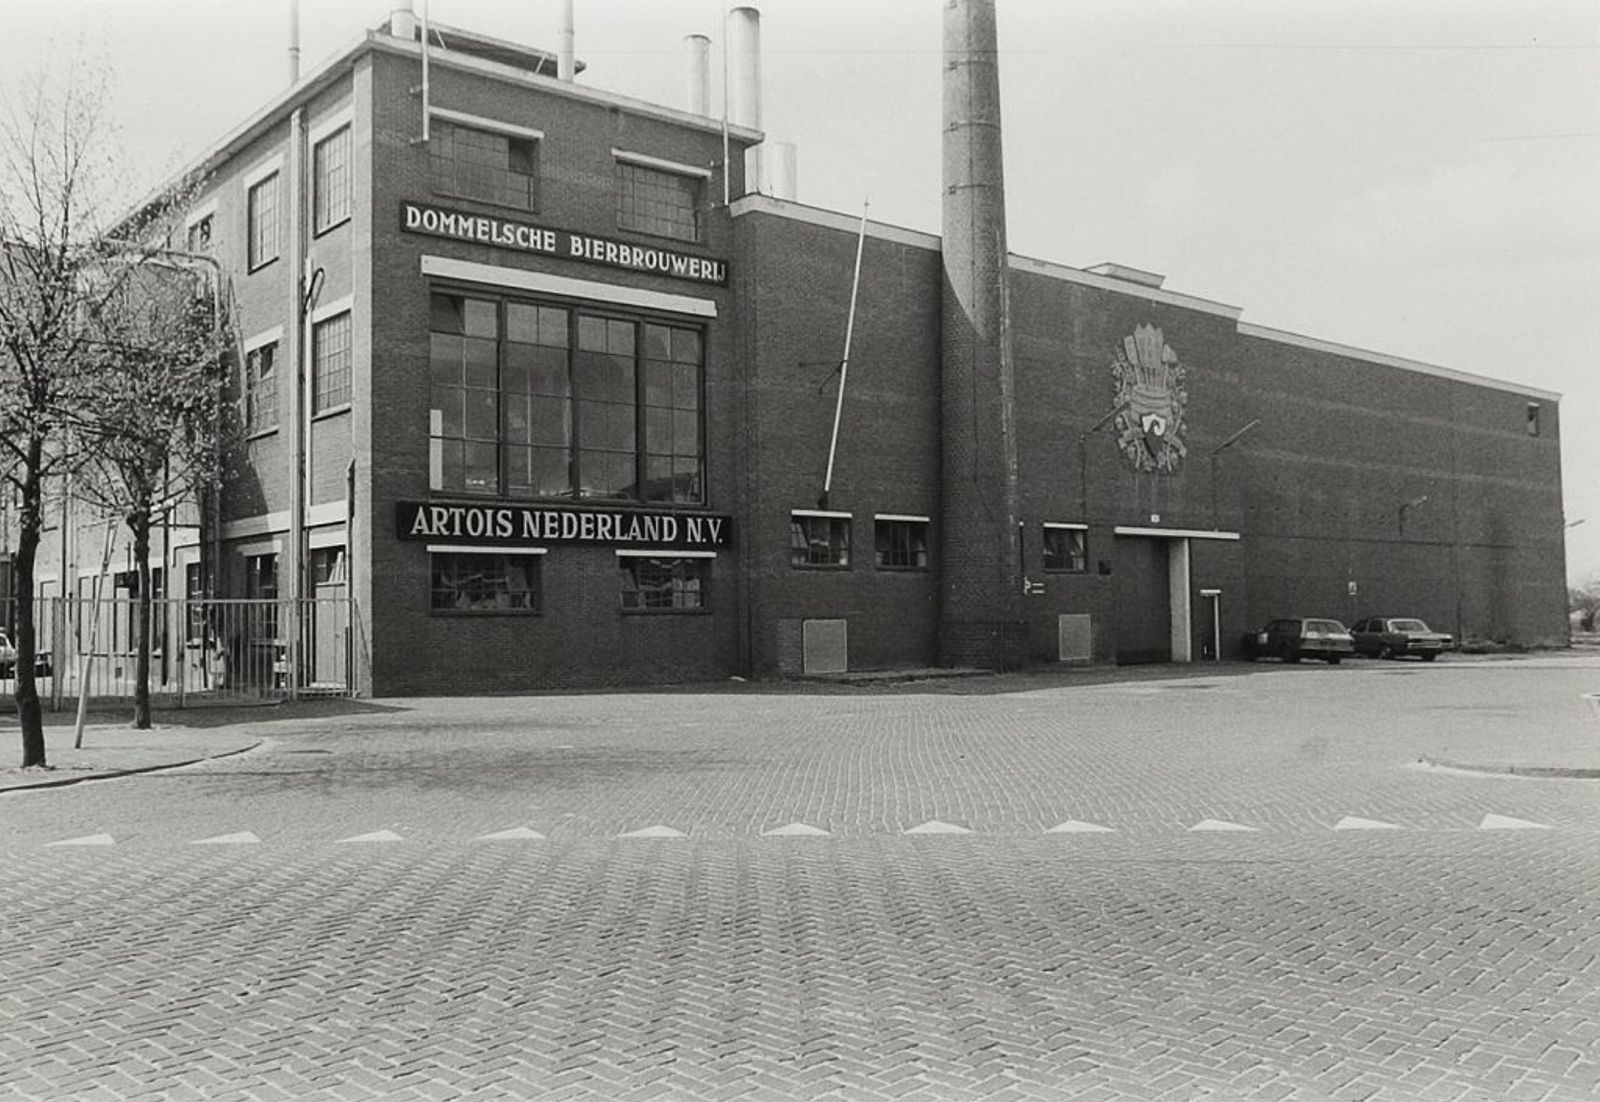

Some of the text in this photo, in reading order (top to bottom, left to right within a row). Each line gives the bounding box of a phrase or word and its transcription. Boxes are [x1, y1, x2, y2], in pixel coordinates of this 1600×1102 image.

[405, 205, 726, 281] DOMMELSCHE BIERBROUWERIJ
[410, 506, 724, 544] ARTOIS NEDERLAND N.V.
